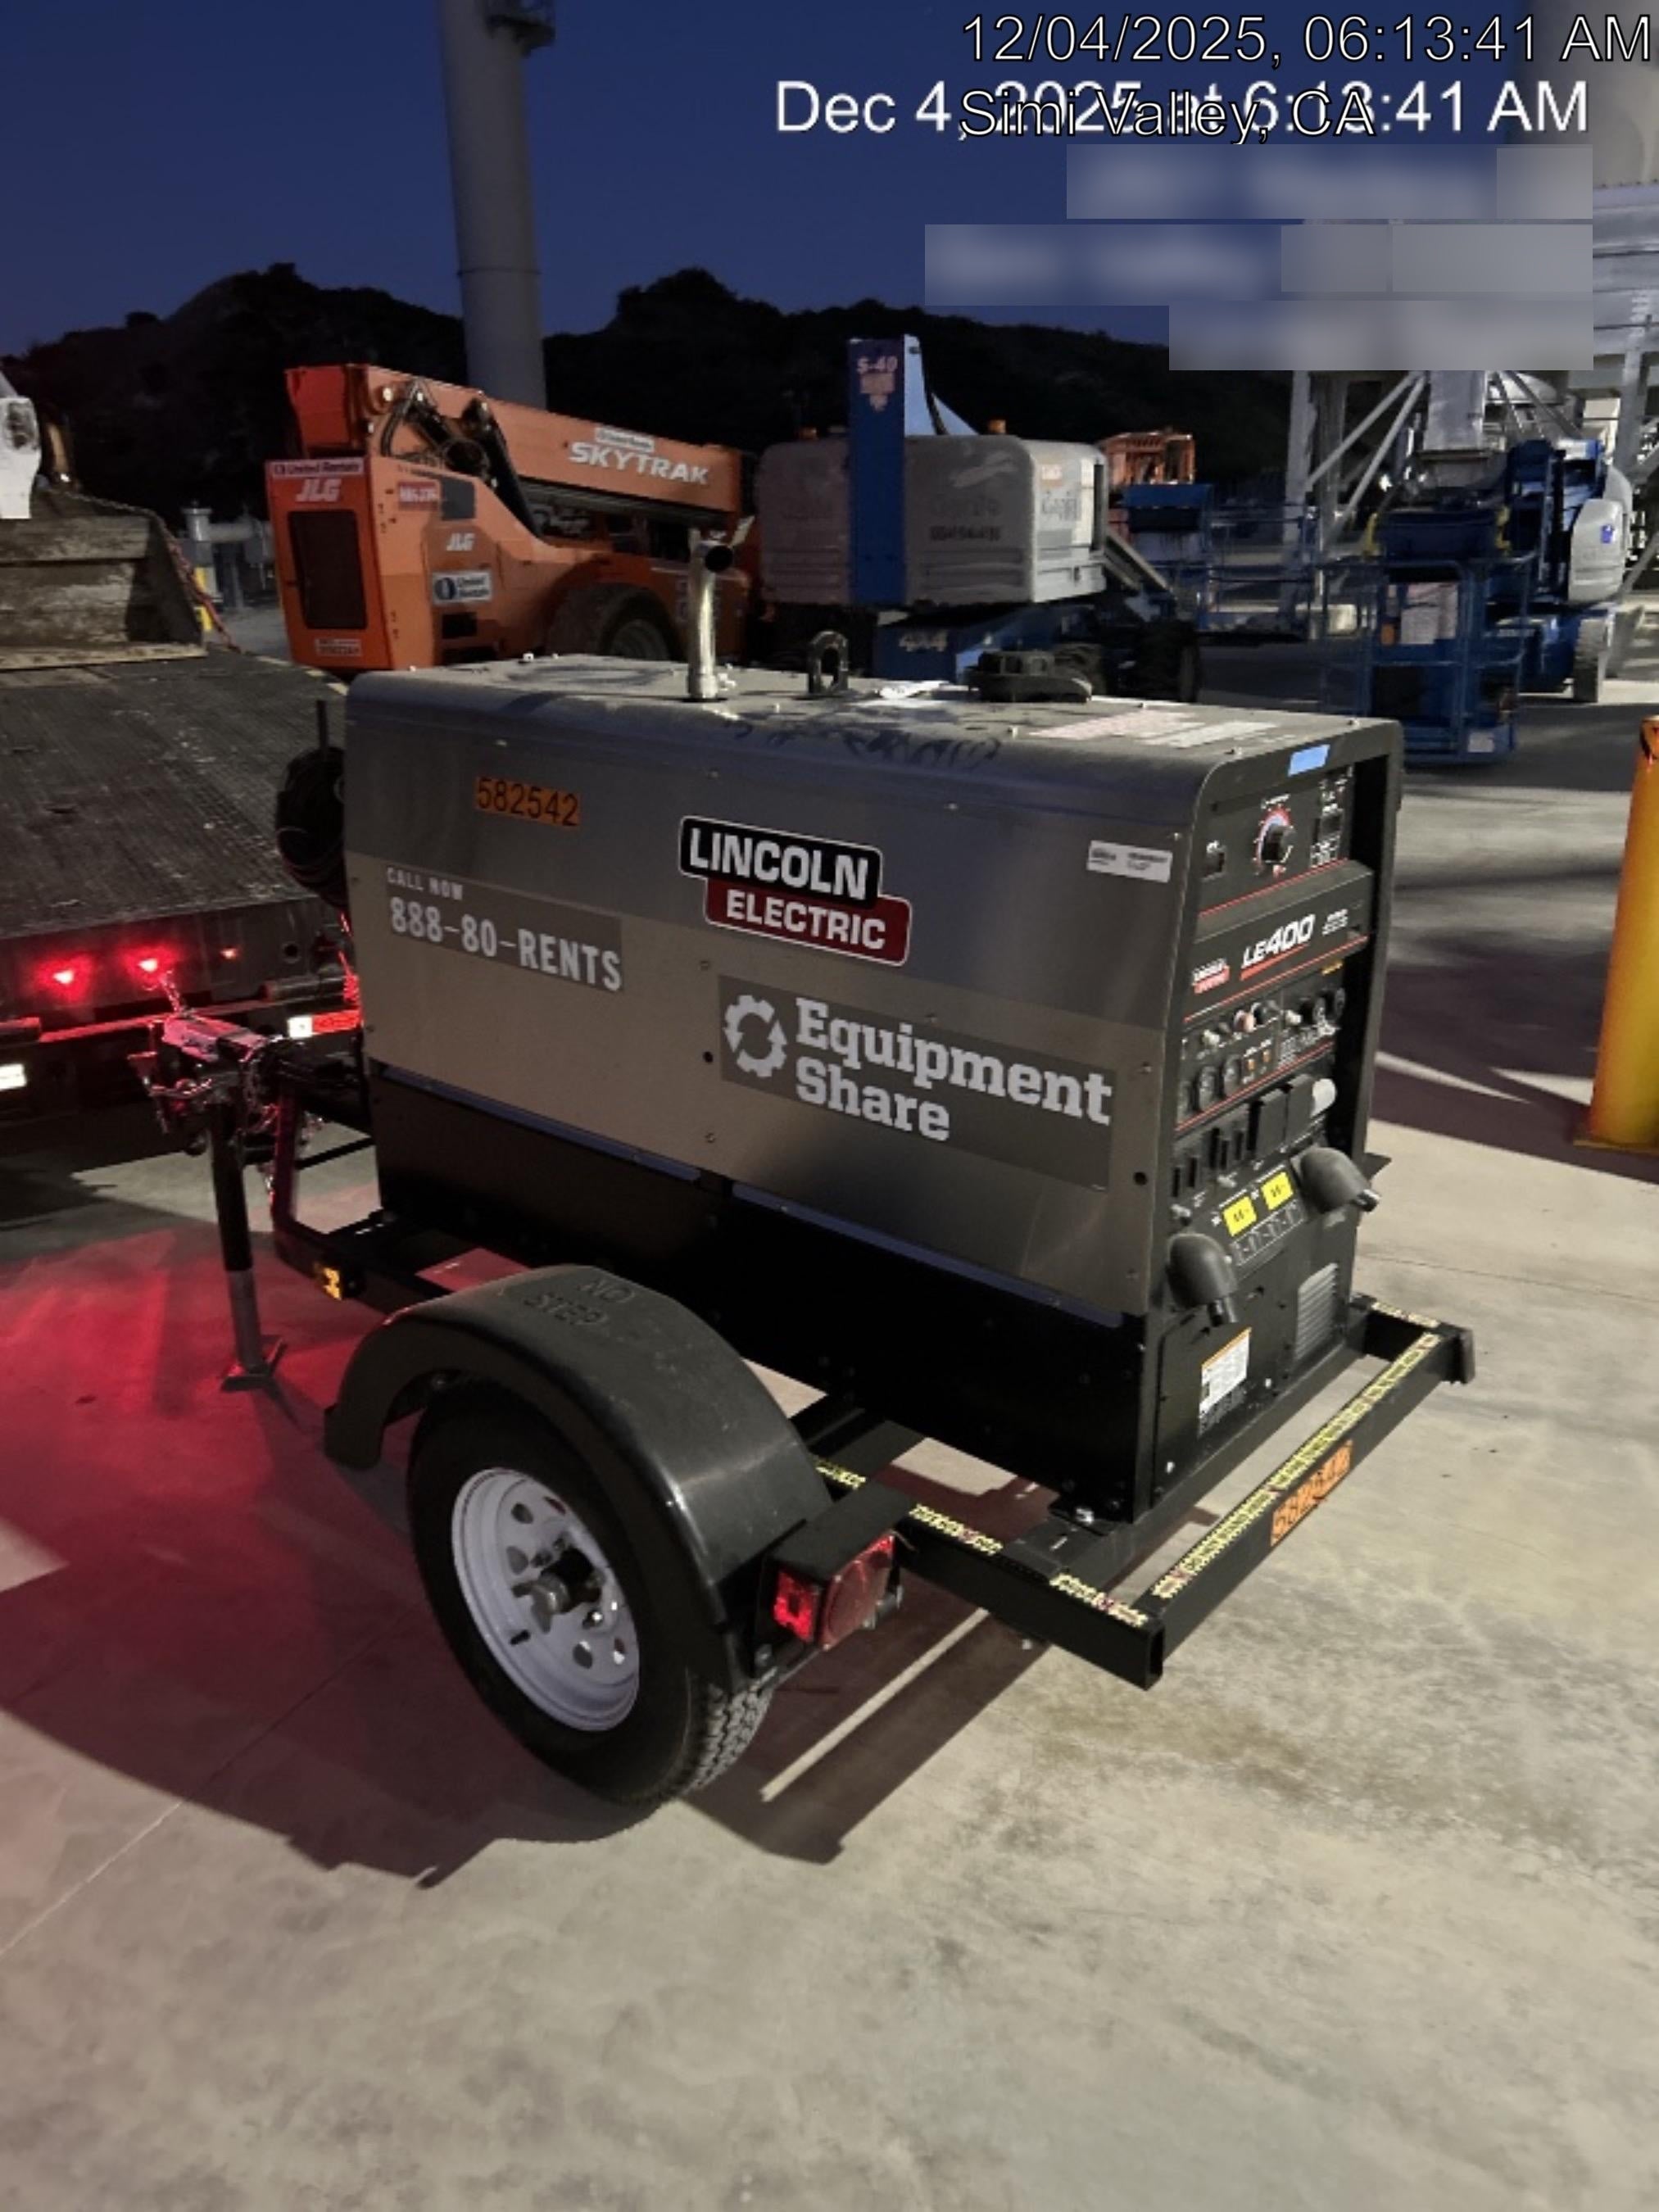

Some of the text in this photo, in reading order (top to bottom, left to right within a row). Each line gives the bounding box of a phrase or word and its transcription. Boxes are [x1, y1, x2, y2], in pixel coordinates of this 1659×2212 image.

[295, 478, 342, 502] JLG
[569, 442, 709, 485] SKYTRAK
[477, 777, 579, 827] 582542
[387, 866, 464, 901] CALL NOW
[688, 827, 869, 901] LINCOLN
[389, 895, 623, 992] 888-80-RENTS
[725, 890, 887, 951] ELECTRIC
[795, 996, 1113, 1126] Equipment
[795, 1056, 951, 1142] Share
